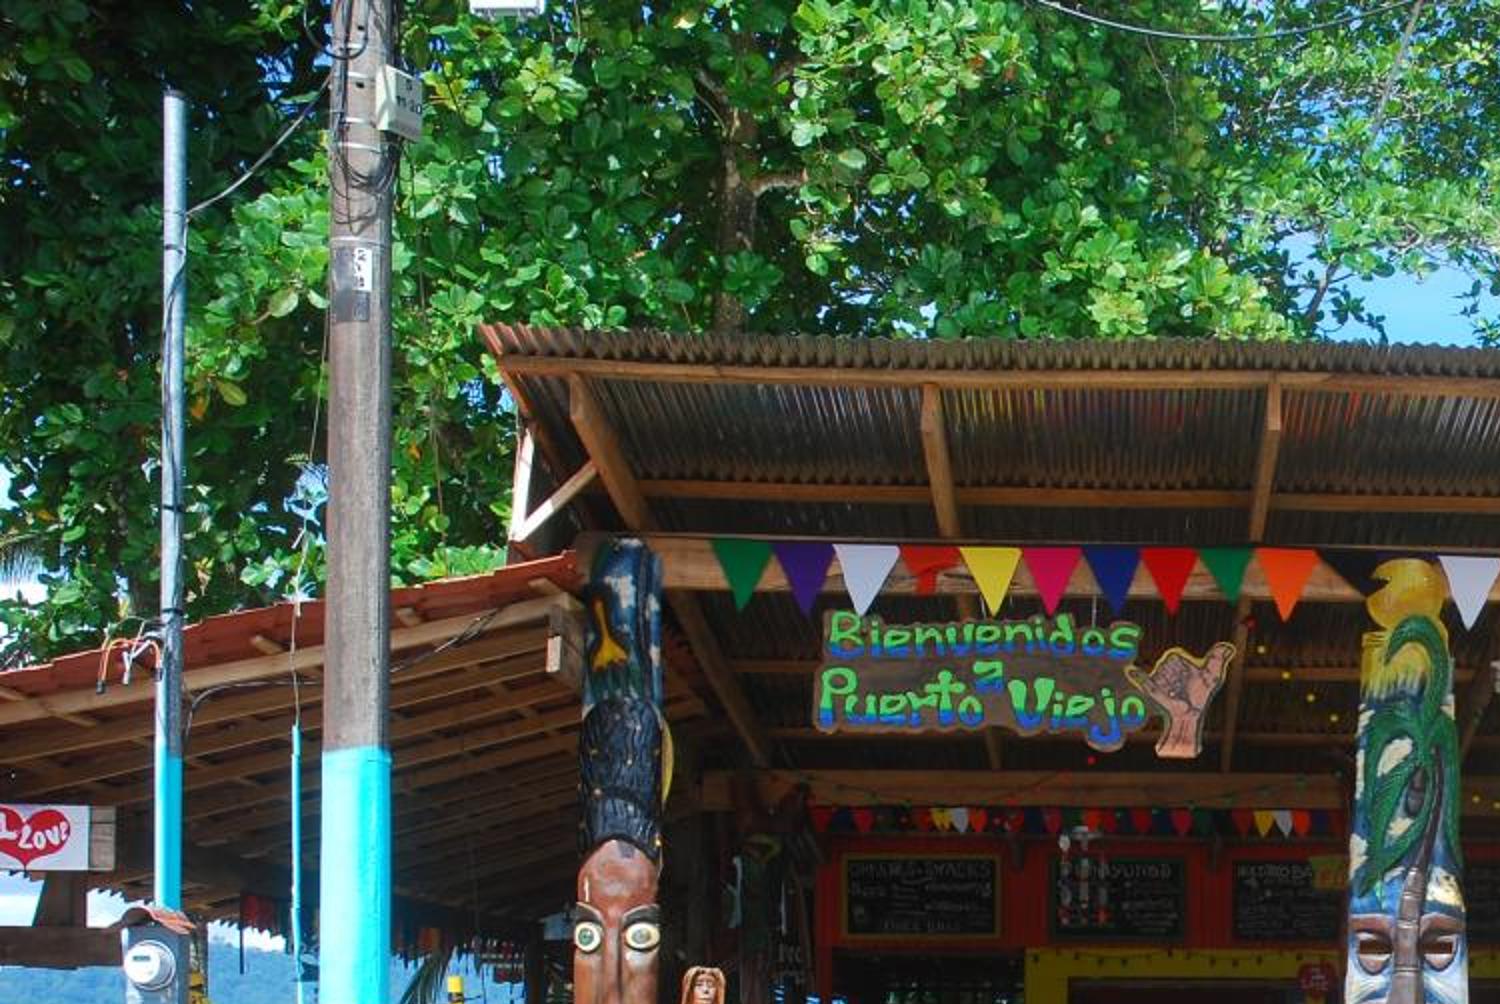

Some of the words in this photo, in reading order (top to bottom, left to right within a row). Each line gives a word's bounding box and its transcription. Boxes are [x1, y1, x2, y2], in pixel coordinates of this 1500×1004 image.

[827, 611, 1141, 658] Bienvenidos
[819, 668, 984, 727] Puerto
[1008, 677, 1146, 746] Viejo
